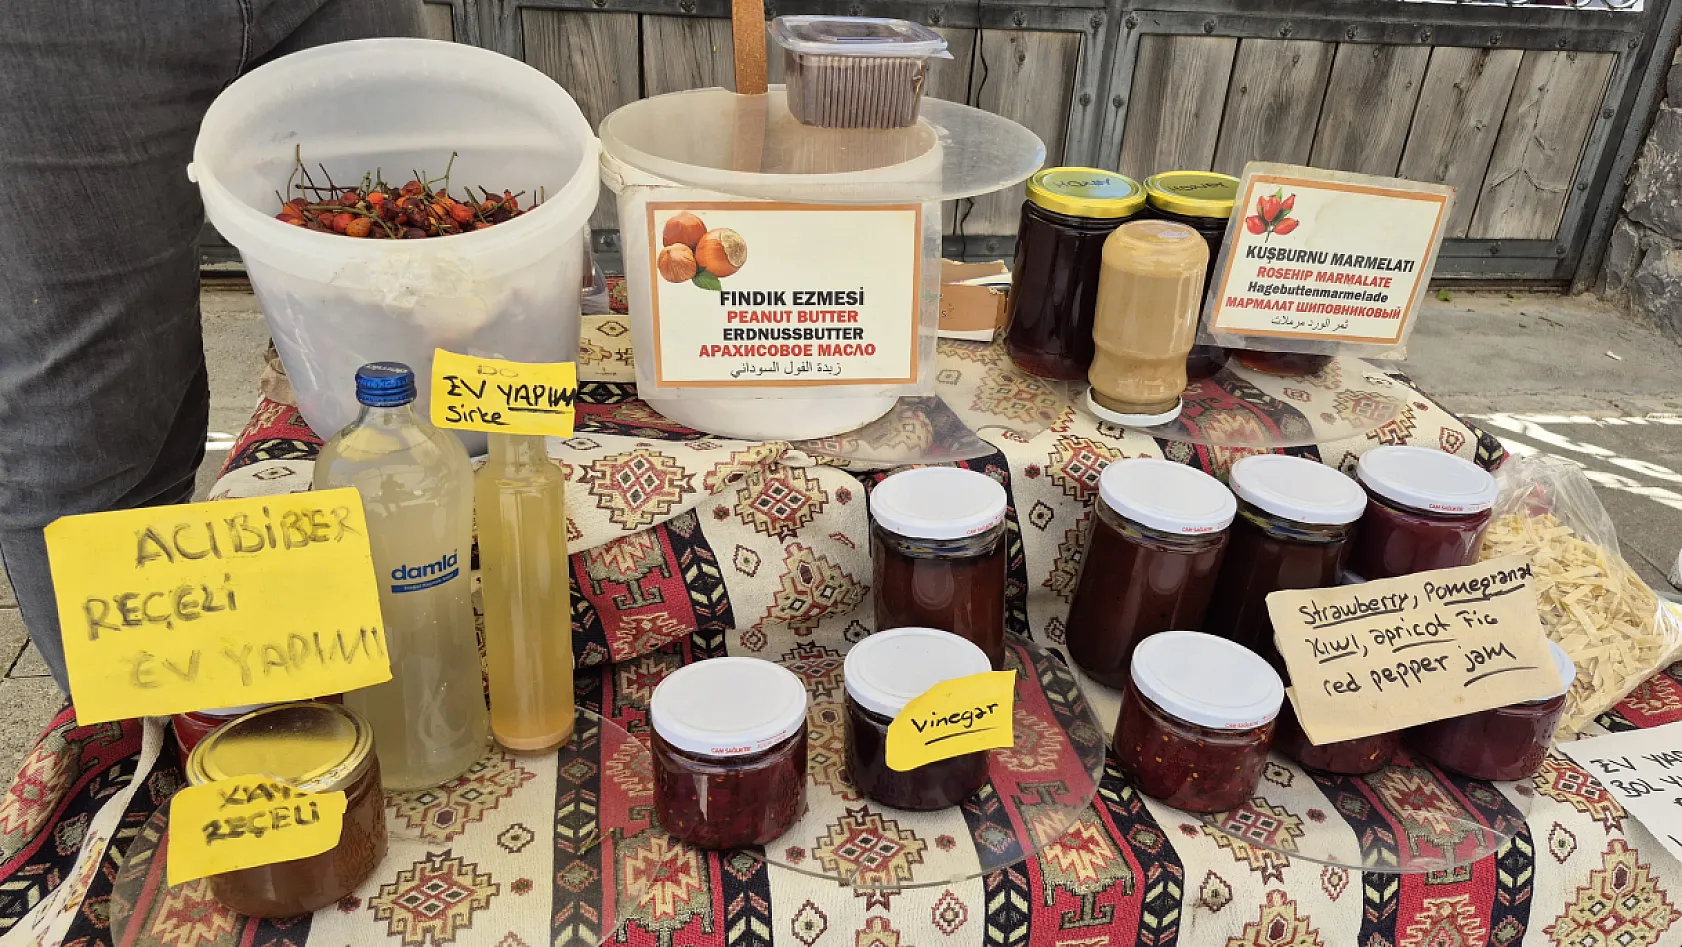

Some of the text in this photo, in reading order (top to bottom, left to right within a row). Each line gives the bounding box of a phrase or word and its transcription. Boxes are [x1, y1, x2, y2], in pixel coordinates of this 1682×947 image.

[1246, 245, 1414, 272] KUŞBURNU MARMELATI
[1257, 266, 1392, 288] ROSEHIP MARMALATE
[720, 287, 864, 306] FINDIK EZMESİ
[1248, 281, 1388, 303] Hagebuttenmarmelade
[727, 310, 858, 323] PEANUT BUTTER
[1225, 297, 1401, 320] МАРМАЛАТ ШИПОВНИКОВЫЙ
[723, 328, 864, 341] ERDNUSSBUTTER
[699, 343, 876, 357] АРАХИСОВОЕ МАСЛО
[730, 361, 842, 378] زبدة الفول السوداني
[442, 375, 487, 399] EV
[445, 404, 510, 425] Sirke
[391, 553, 458, 580] damla
[1369, 613, 1451, 647] apricot
[130, 649, 200, 690] EV
[1323, 642, 1517, 697] red pepper jam
